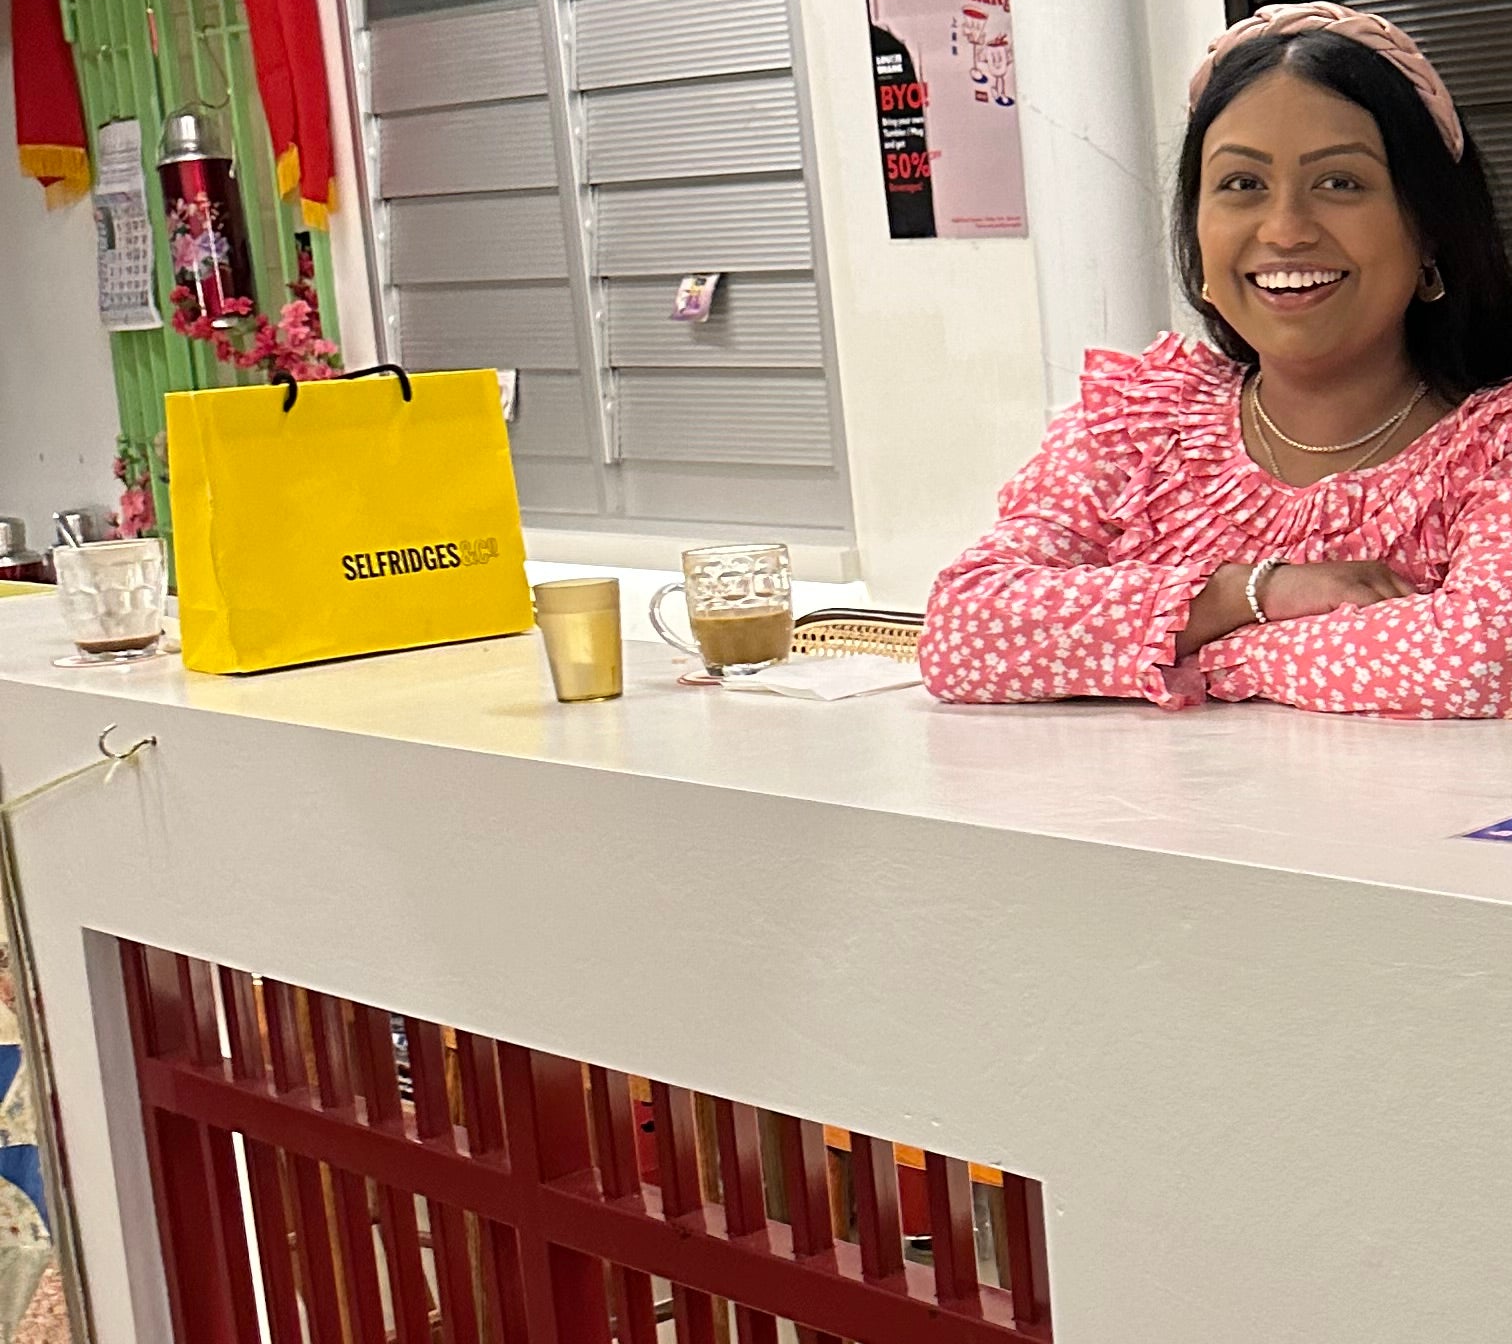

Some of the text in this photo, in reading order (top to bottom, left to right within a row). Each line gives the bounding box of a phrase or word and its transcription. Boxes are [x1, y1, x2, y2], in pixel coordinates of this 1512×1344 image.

[880, 82, 930, 111] BYO!
[887, 152, 931, 179] 50%
[342, 543, 461, 581] SELFRIDGES
